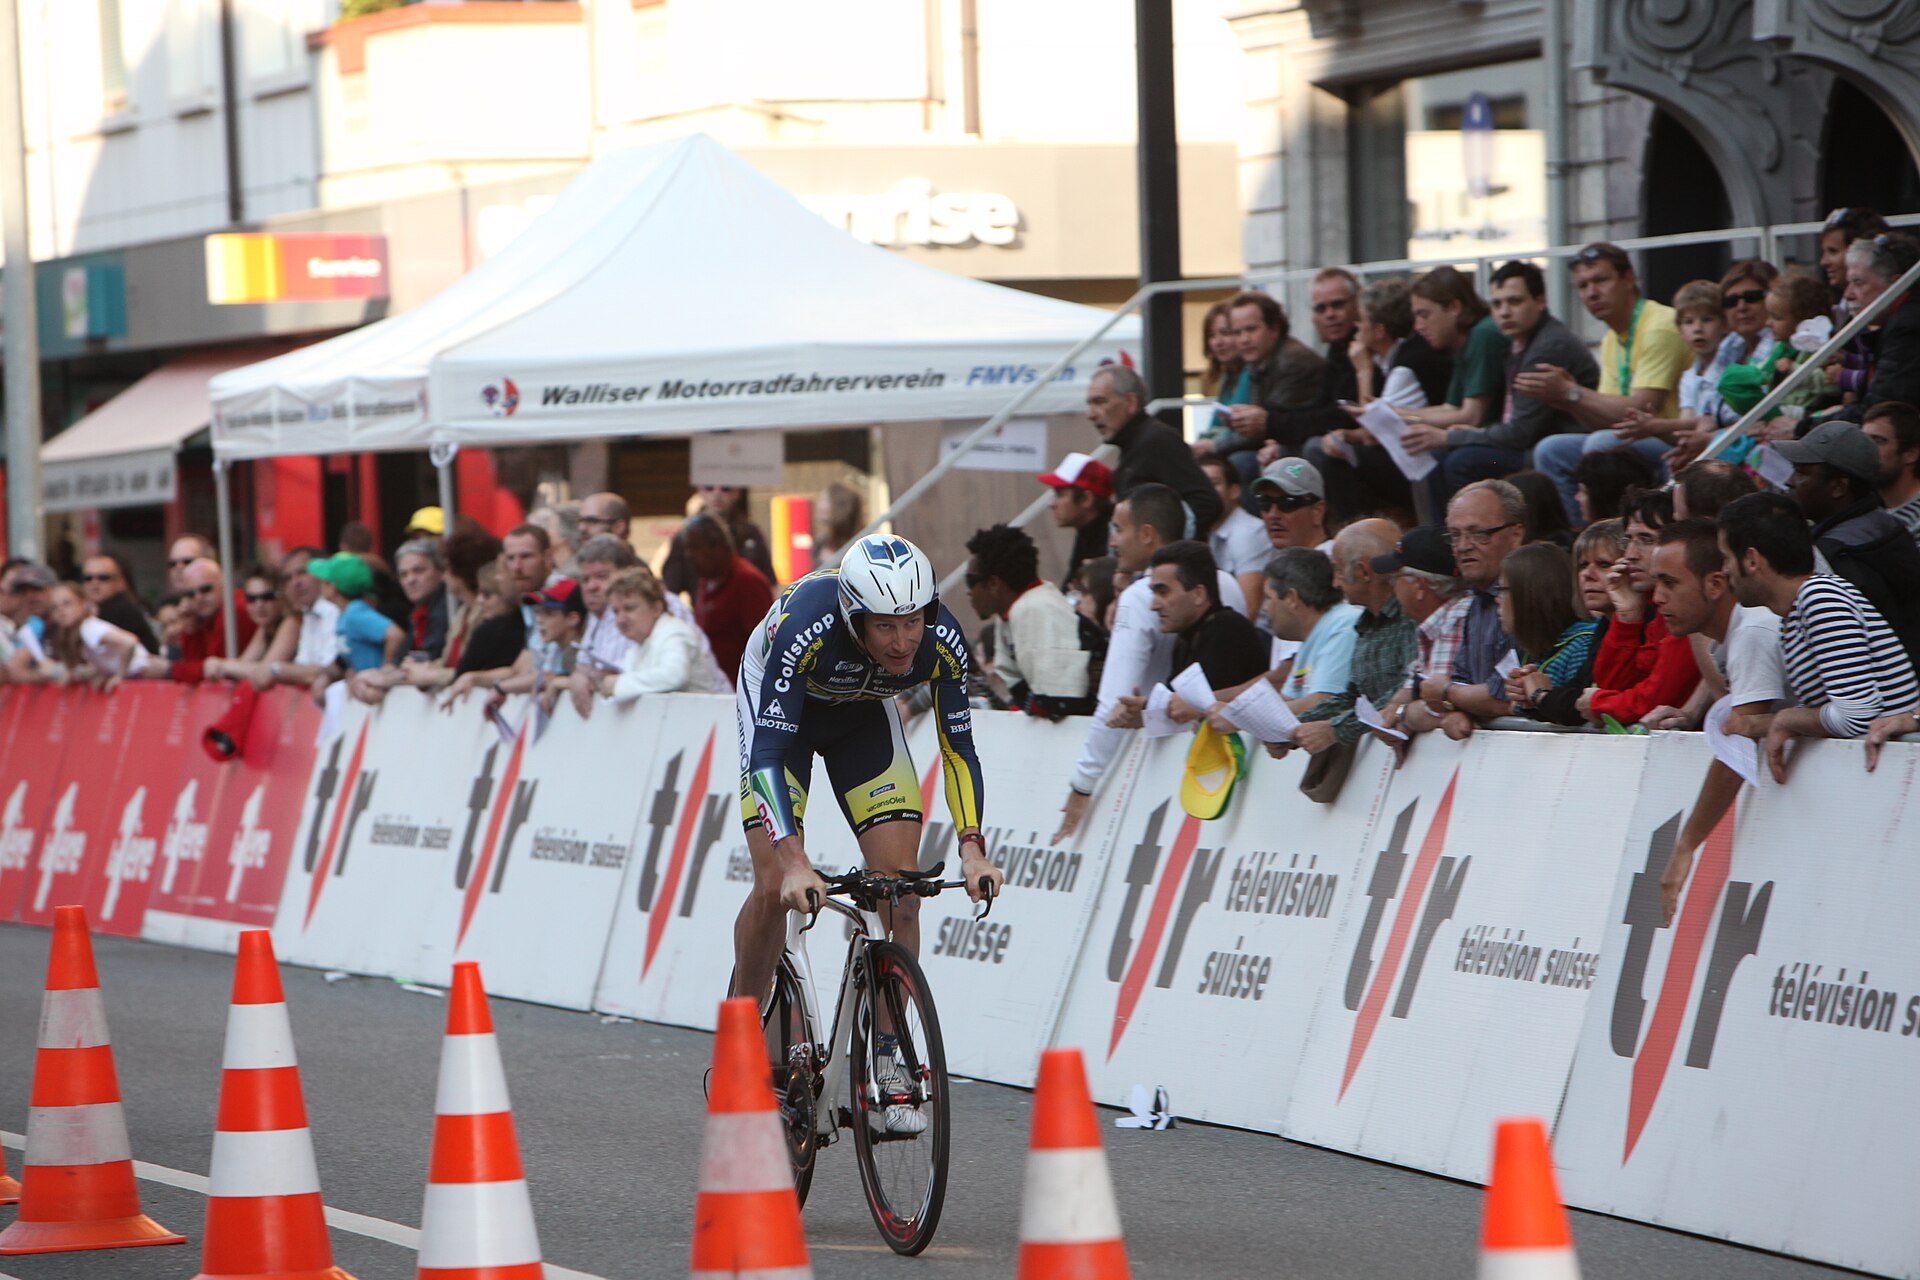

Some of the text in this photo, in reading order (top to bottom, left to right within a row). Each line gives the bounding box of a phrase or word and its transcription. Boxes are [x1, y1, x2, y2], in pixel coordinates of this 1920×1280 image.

[542, 383, 651, 405] Walliser
[657, 368, 945, 401] Motorradfahrerverein
[775, 613, 834, 692] Collstrop
[926, 625, 968, 695] ollstrop
[982, 827, 1082, 893] lévision
[1225, 851, 1338, 919] télévision
[931, 903, 1012, 964] suisse
[1454, 925, 1600, 990] télévision suisse
[1197, 936, 1271, 1000] suisse
[1769, 962, 1897, 1033] télévision
